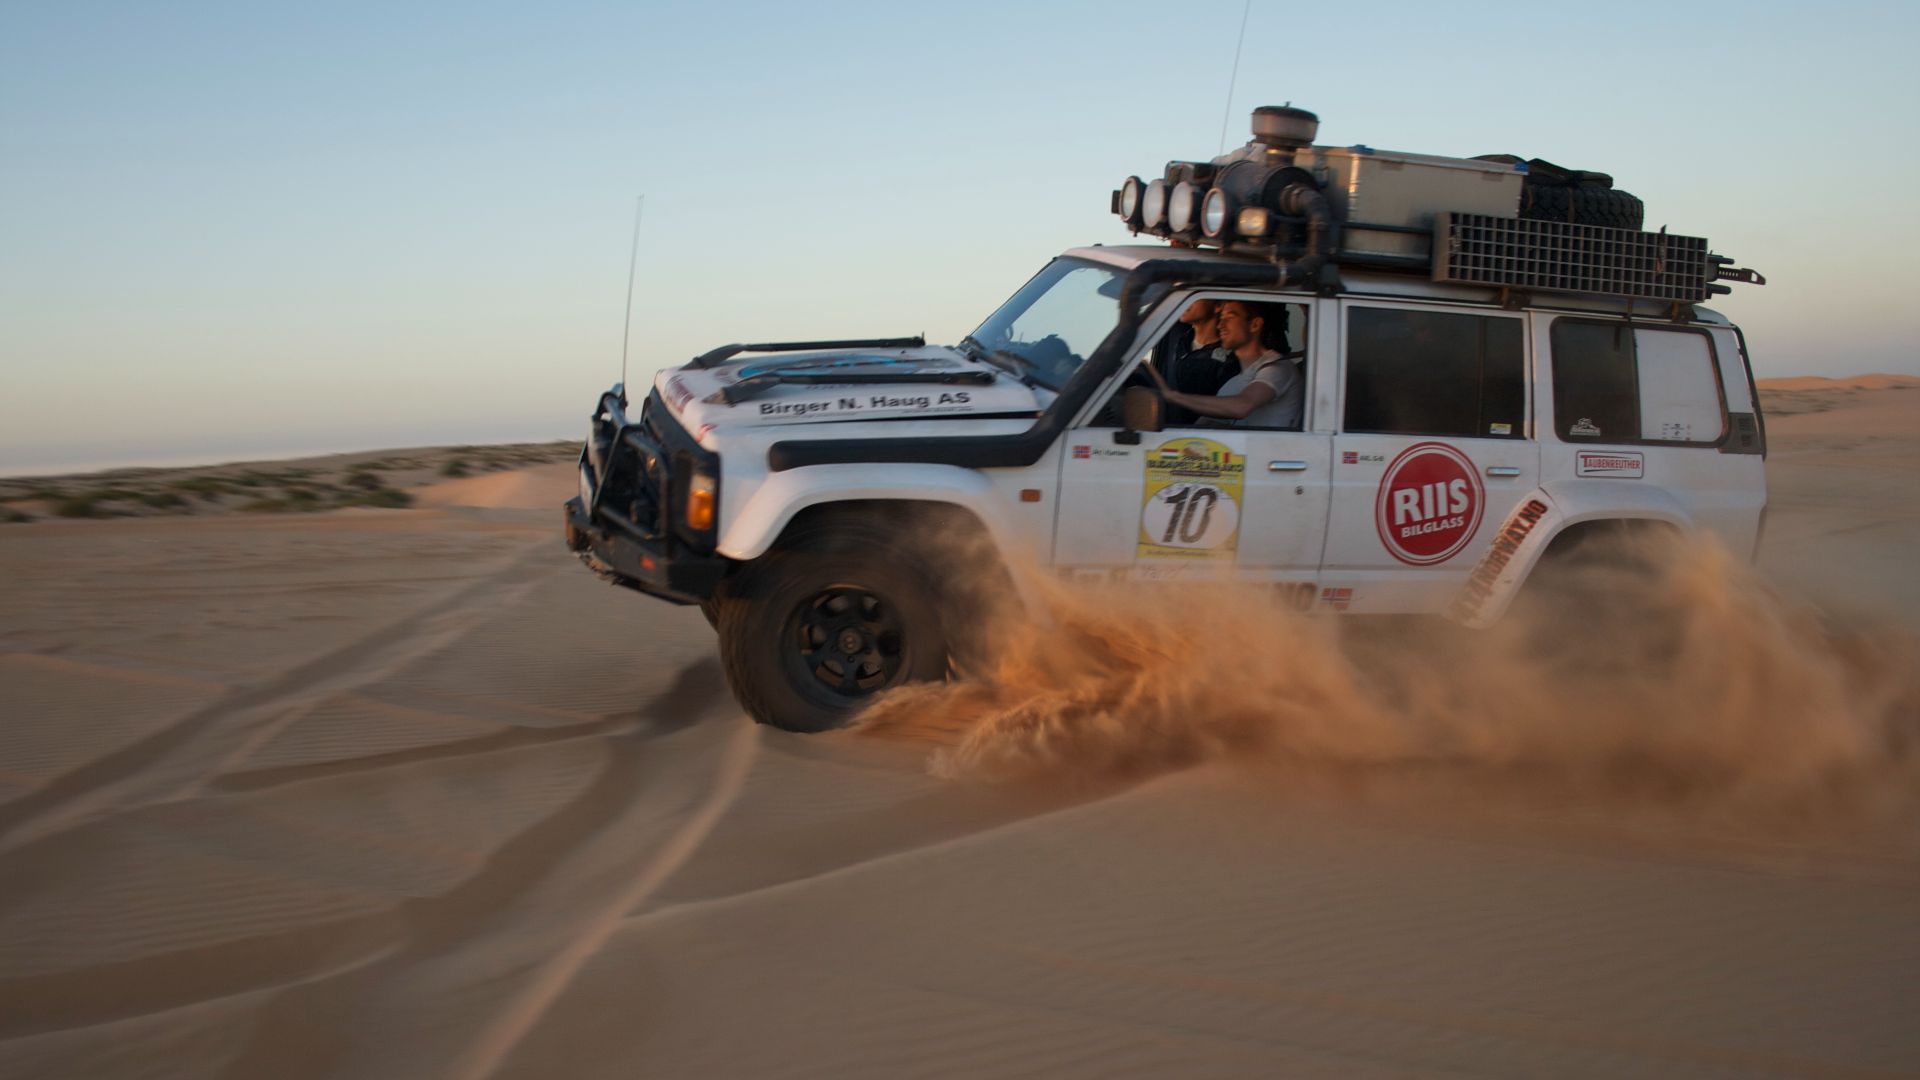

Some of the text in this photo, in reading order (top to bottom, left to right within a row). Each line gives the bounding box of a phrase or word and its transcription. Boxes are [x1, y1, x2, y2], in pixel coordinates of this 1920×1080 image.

[759, 401, 832, 415] Birger
[838, 397, 863, 410] N.
[870, 394, 931, 408] Haug
[937, 391, 972, 404] AS
[1583, 456, 1640, 469] TAUBENREUTHER
[1393, 478, 1469, 525] RIIS
[1163, 486, 1217, 543] 10
[1401, 516, 1464, 537] BILGLASS
